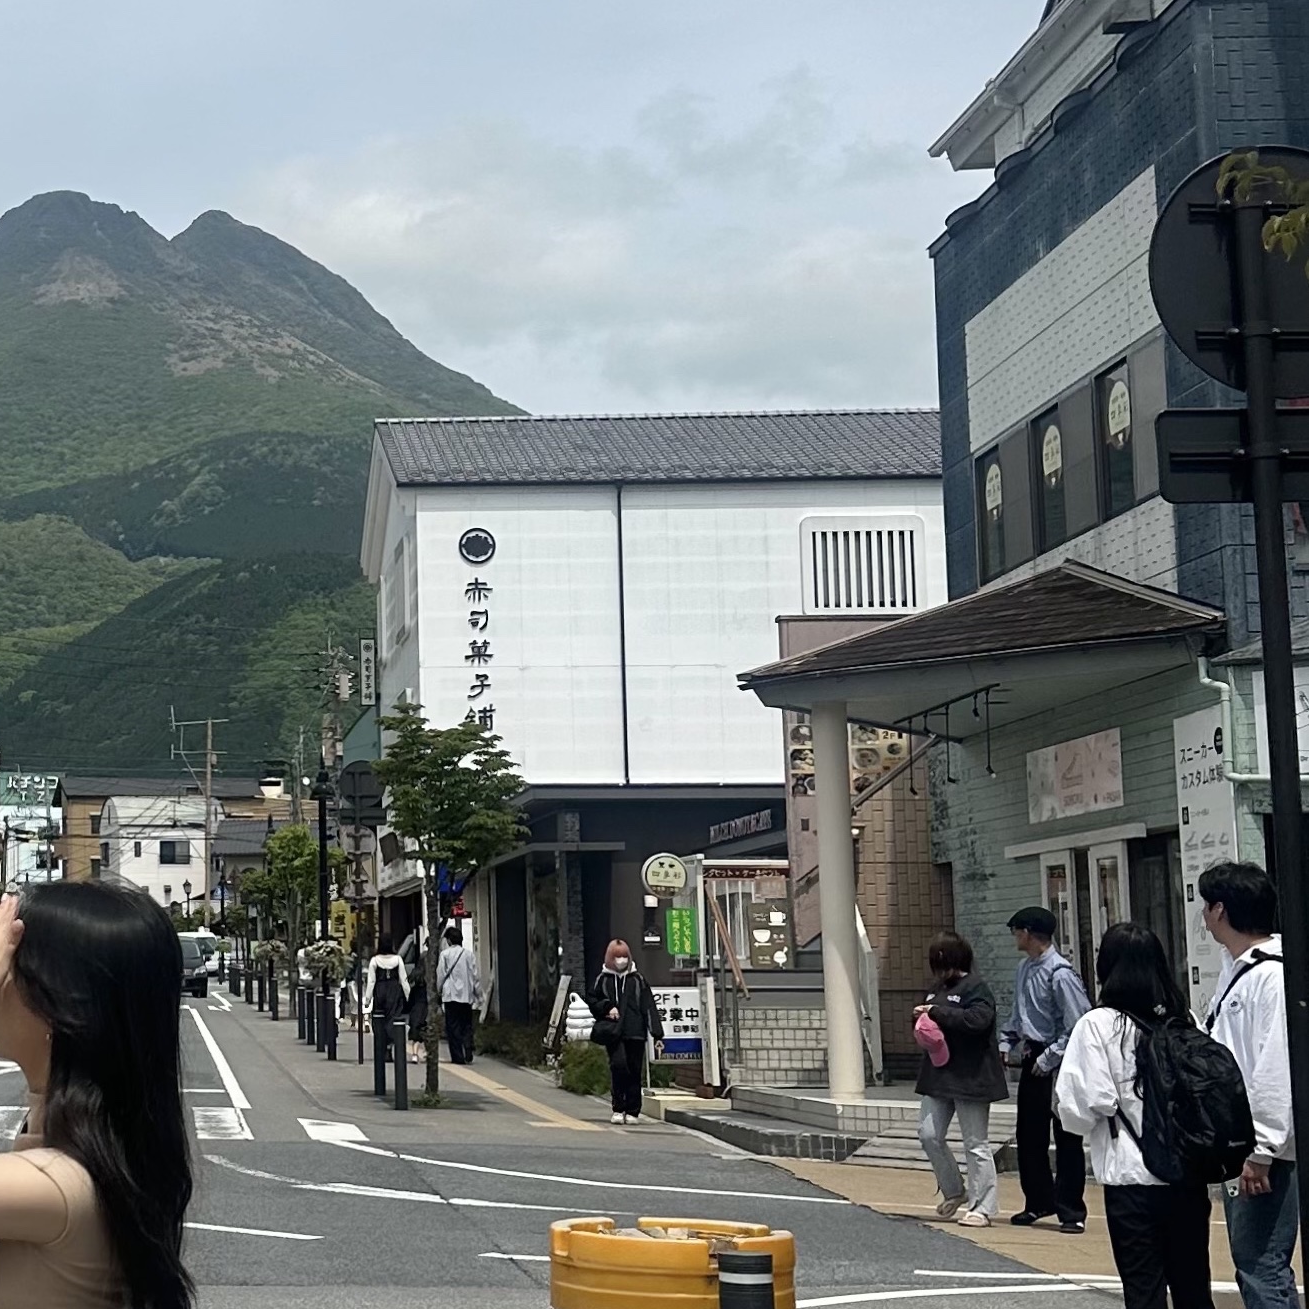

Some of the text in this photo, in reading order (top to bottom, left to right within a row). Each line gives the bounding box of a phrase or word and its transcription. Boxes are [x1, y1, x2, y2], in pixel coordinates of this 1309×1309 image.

[1179, 743, 1214, 764] スニーカー
[653, 993, 671, 1006] 2F
